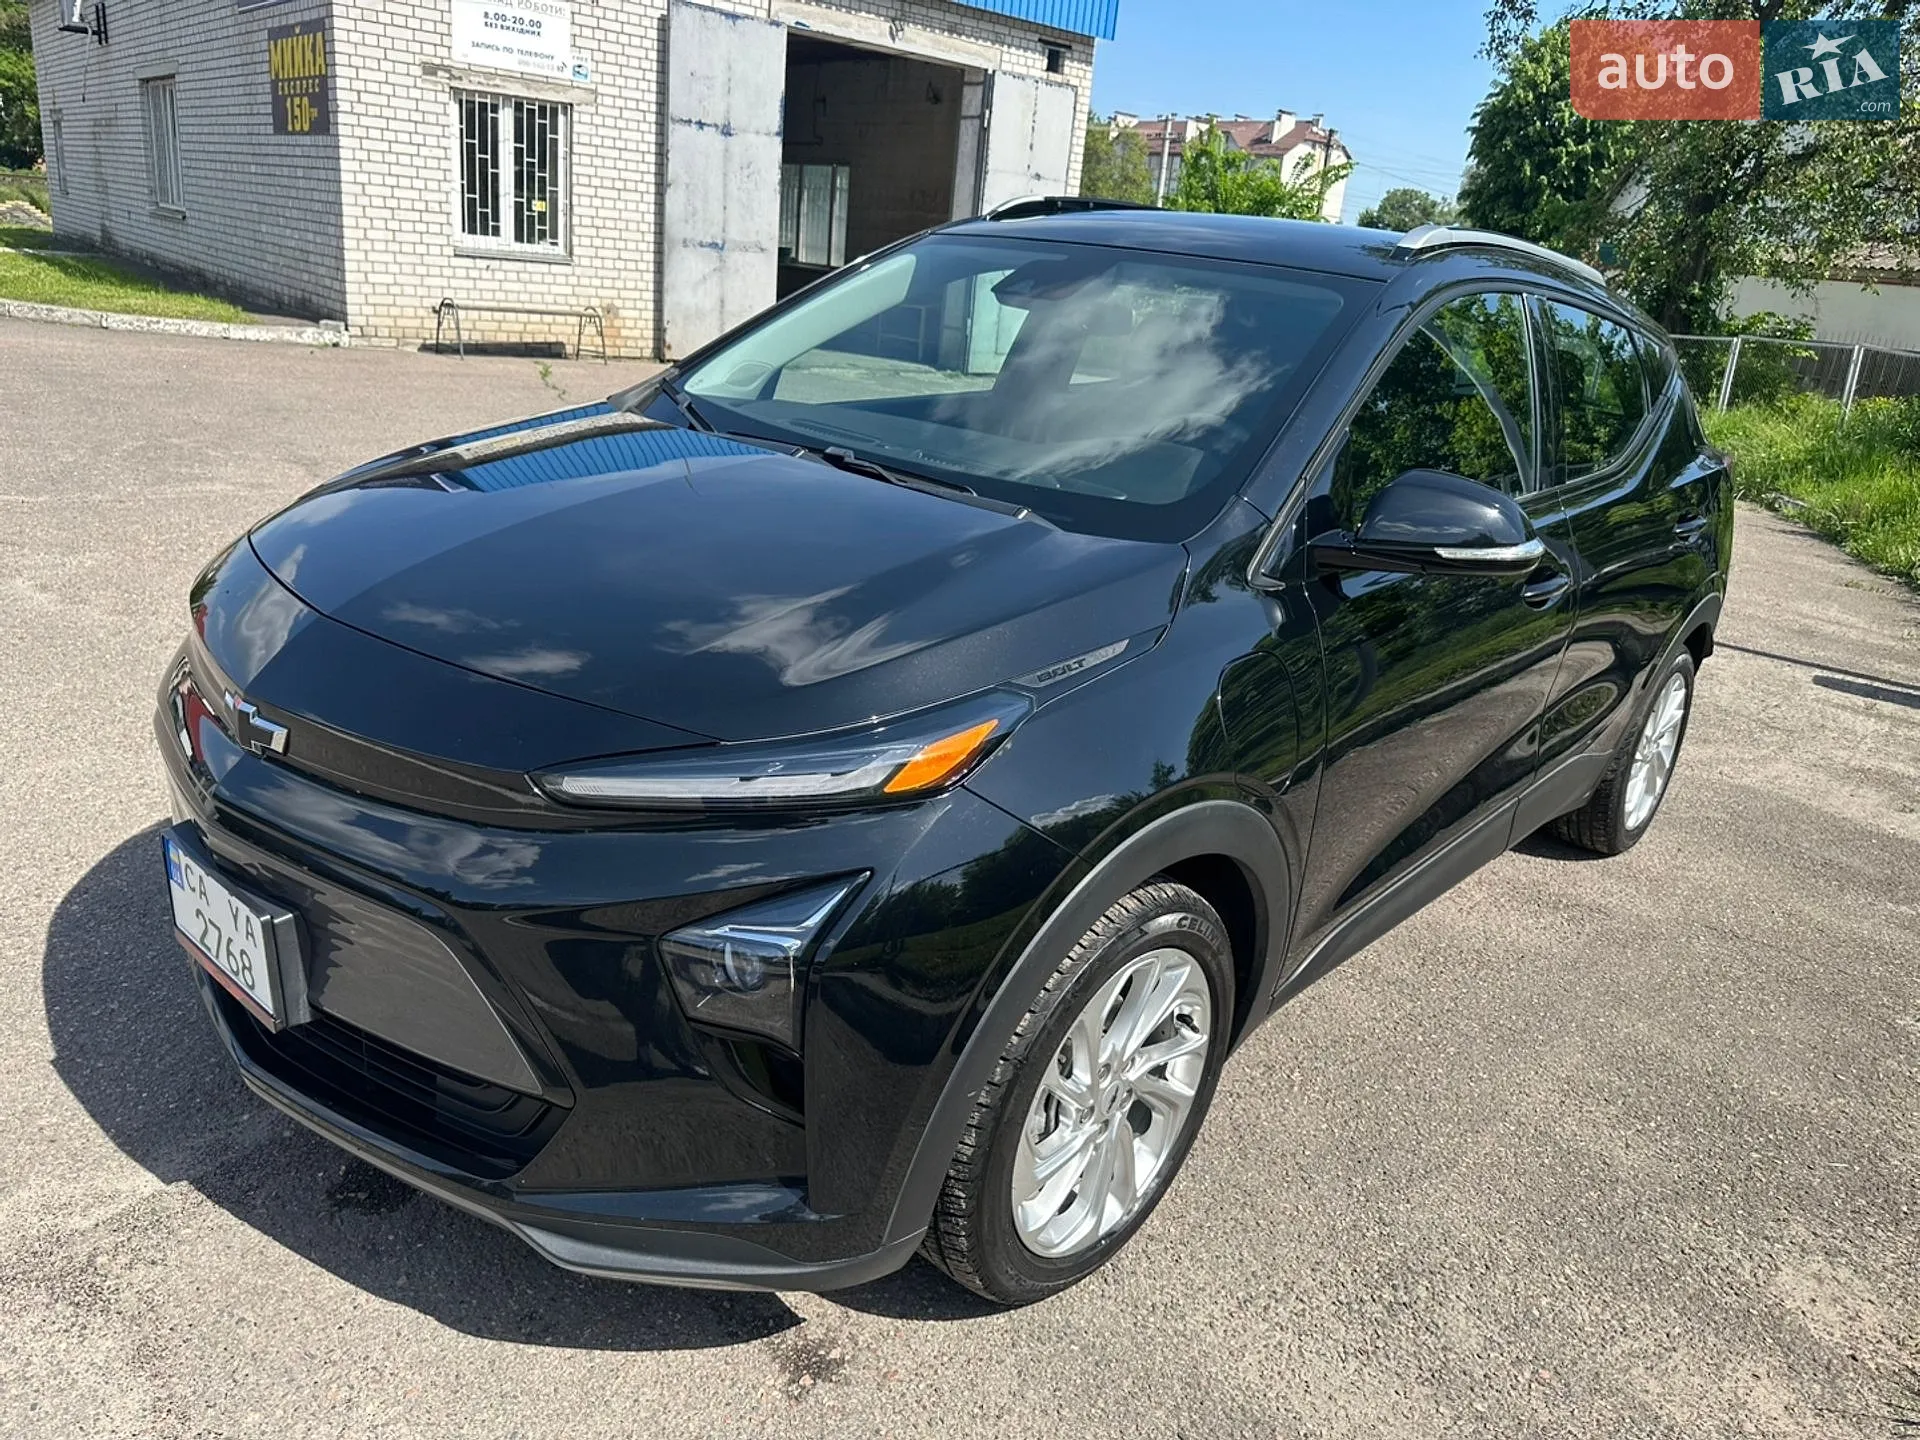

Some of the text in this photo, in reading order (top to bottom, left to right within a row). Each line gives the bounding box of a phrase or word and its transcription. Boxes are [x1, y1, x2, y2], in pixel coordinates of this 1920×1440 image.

[483, 11, 543, 29] 8.00-20.00
[484, 21, 499, 30] БЕЗ
[270, 24, 326, 80] МИЙКА
[471, 41, 501, 53] ЗАПИСЬ
[502, 46, 514, 55] ПО
[1036, 658, 1087, 682] BOLT
[184, 862, 210, 907] CA
[195, 908, 255, 991] 2768
